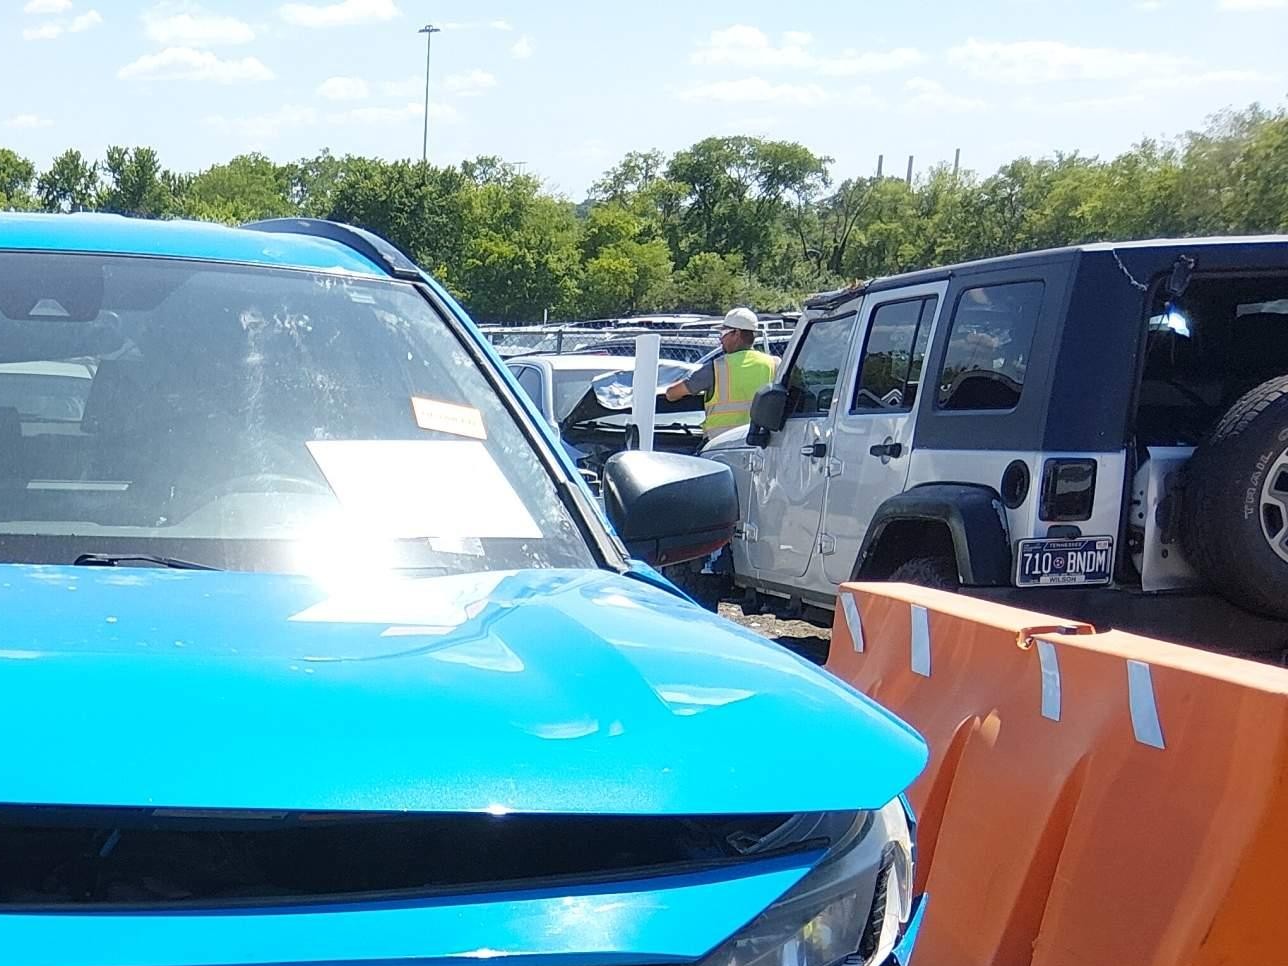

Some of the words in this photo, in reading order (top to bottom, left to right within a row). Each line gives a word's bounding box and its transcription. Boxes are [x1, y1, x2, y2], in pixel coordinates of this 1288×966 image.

[1049, 541, 1082, 549] TENNESSEE
[1023, 552, 1052, 575] 710
[1066, 550, 1106, 574] BNDM
[1049, 575, 1077, 583] WILSON
